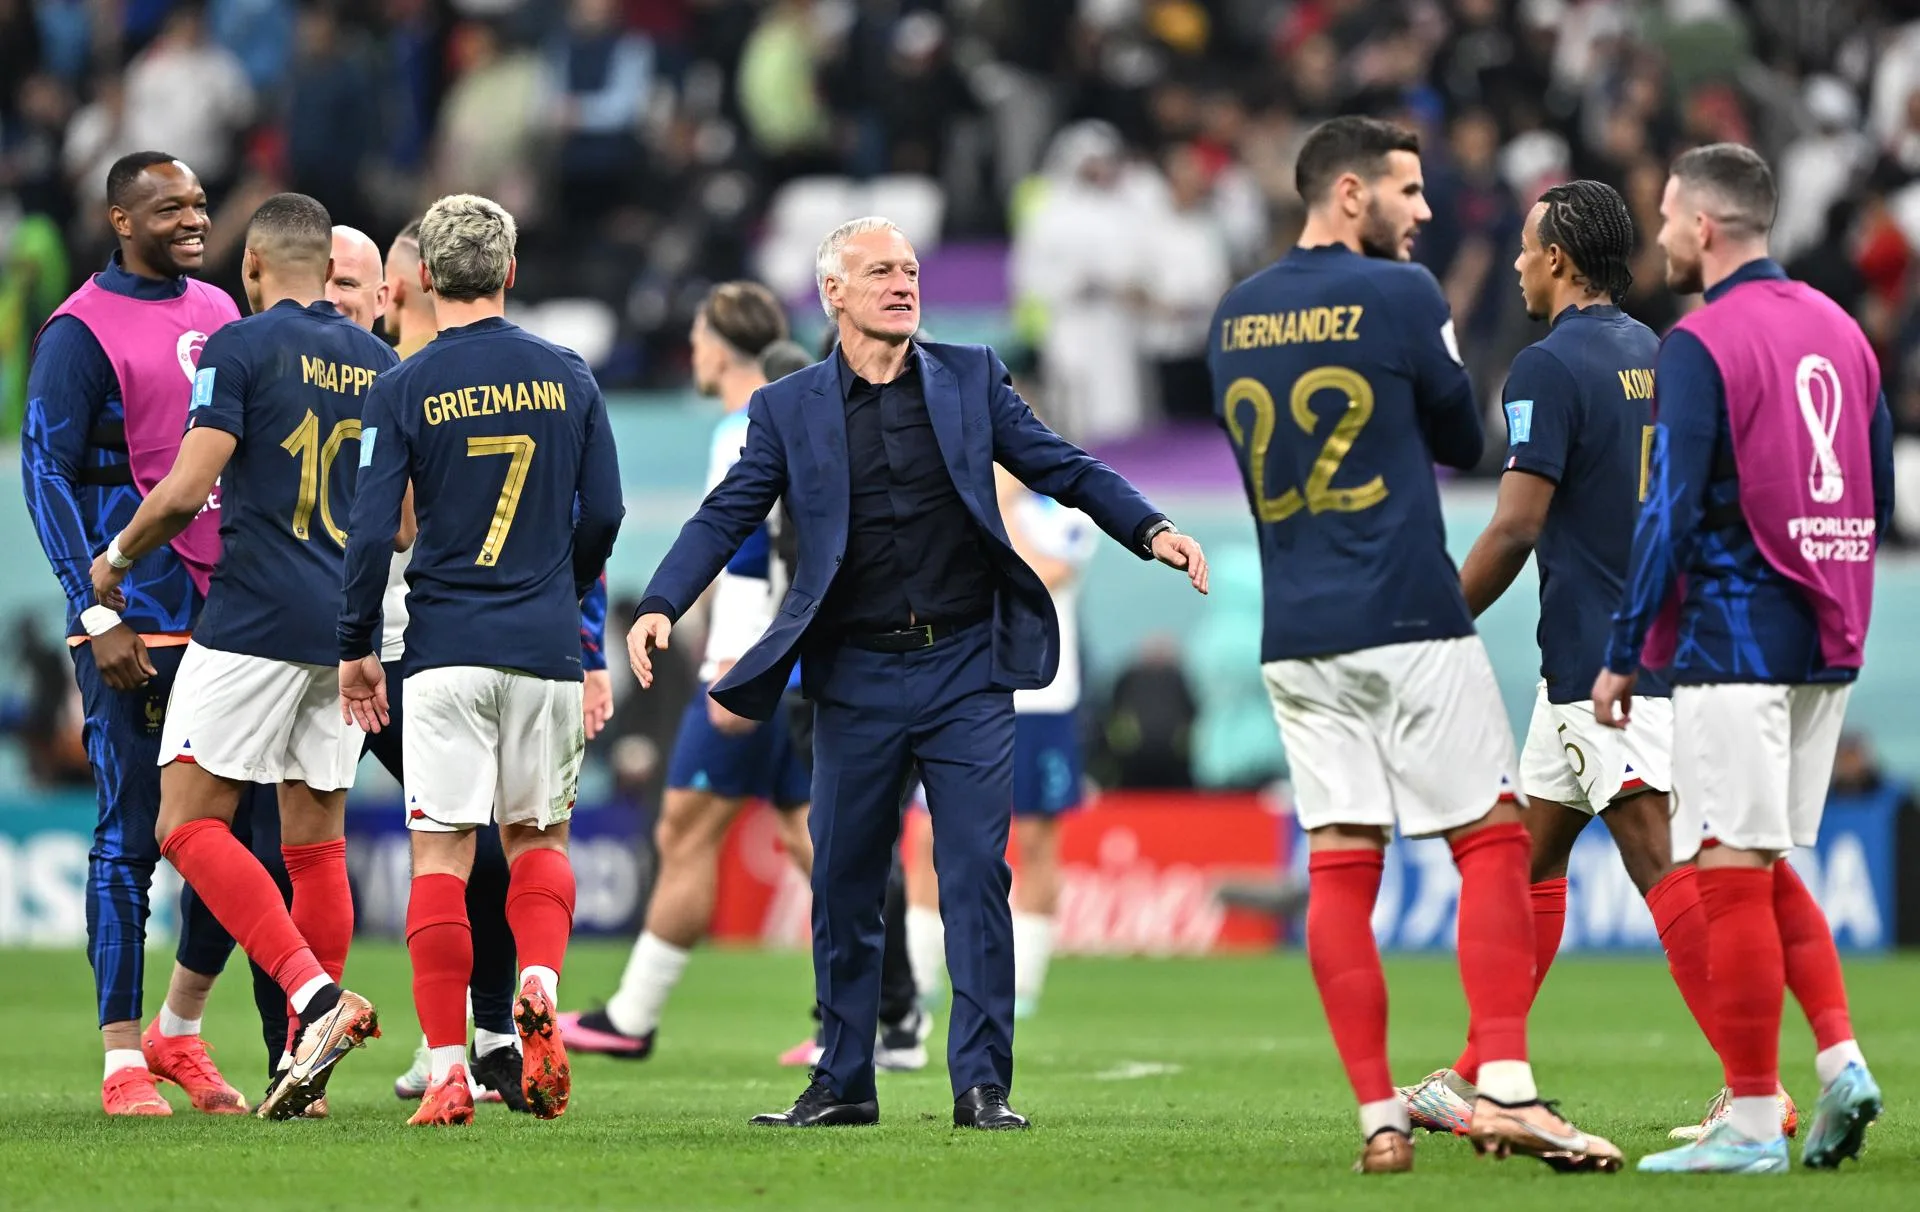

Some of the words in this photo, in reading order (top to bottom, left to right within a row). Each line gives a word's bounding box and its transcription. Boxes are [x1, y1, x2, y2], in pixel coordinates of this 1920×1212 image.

[423, 380, 567, 426] GRIEZMANN
[1224, 365, 1389, 523] 22
[280, 407, 362, 549] 10
[466, 434, 537, 567] 7
